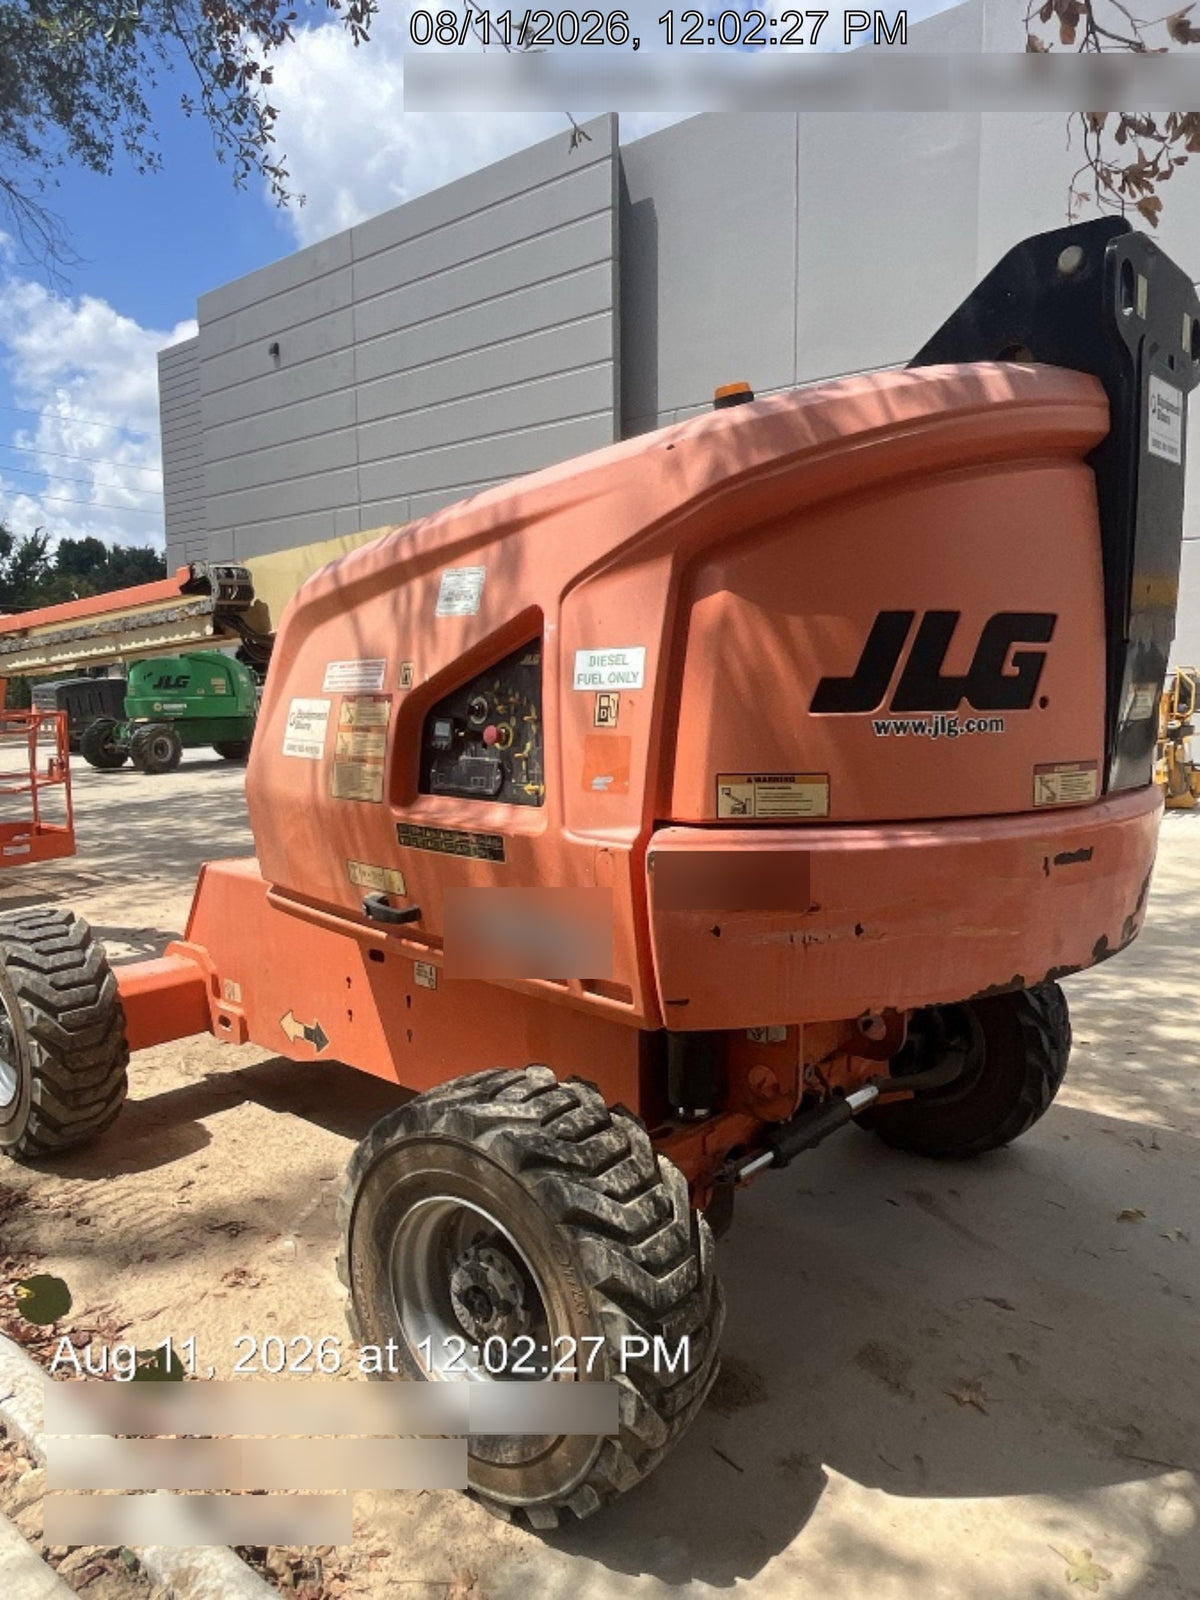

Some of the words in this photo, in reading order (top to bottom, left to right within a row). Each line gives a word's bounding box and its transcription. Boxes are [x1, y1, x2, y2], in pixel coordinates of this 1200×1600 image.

[588, 653, 630, 668] DIESEL
[808, 610, 1058, 713] JLG
[152, 674, 191, 689] JLG
[577, 672, 605, 686] FUEL
[607, 671, 640, 684] ONLY
[873, 716, 1005, 739] www.jlg.com
